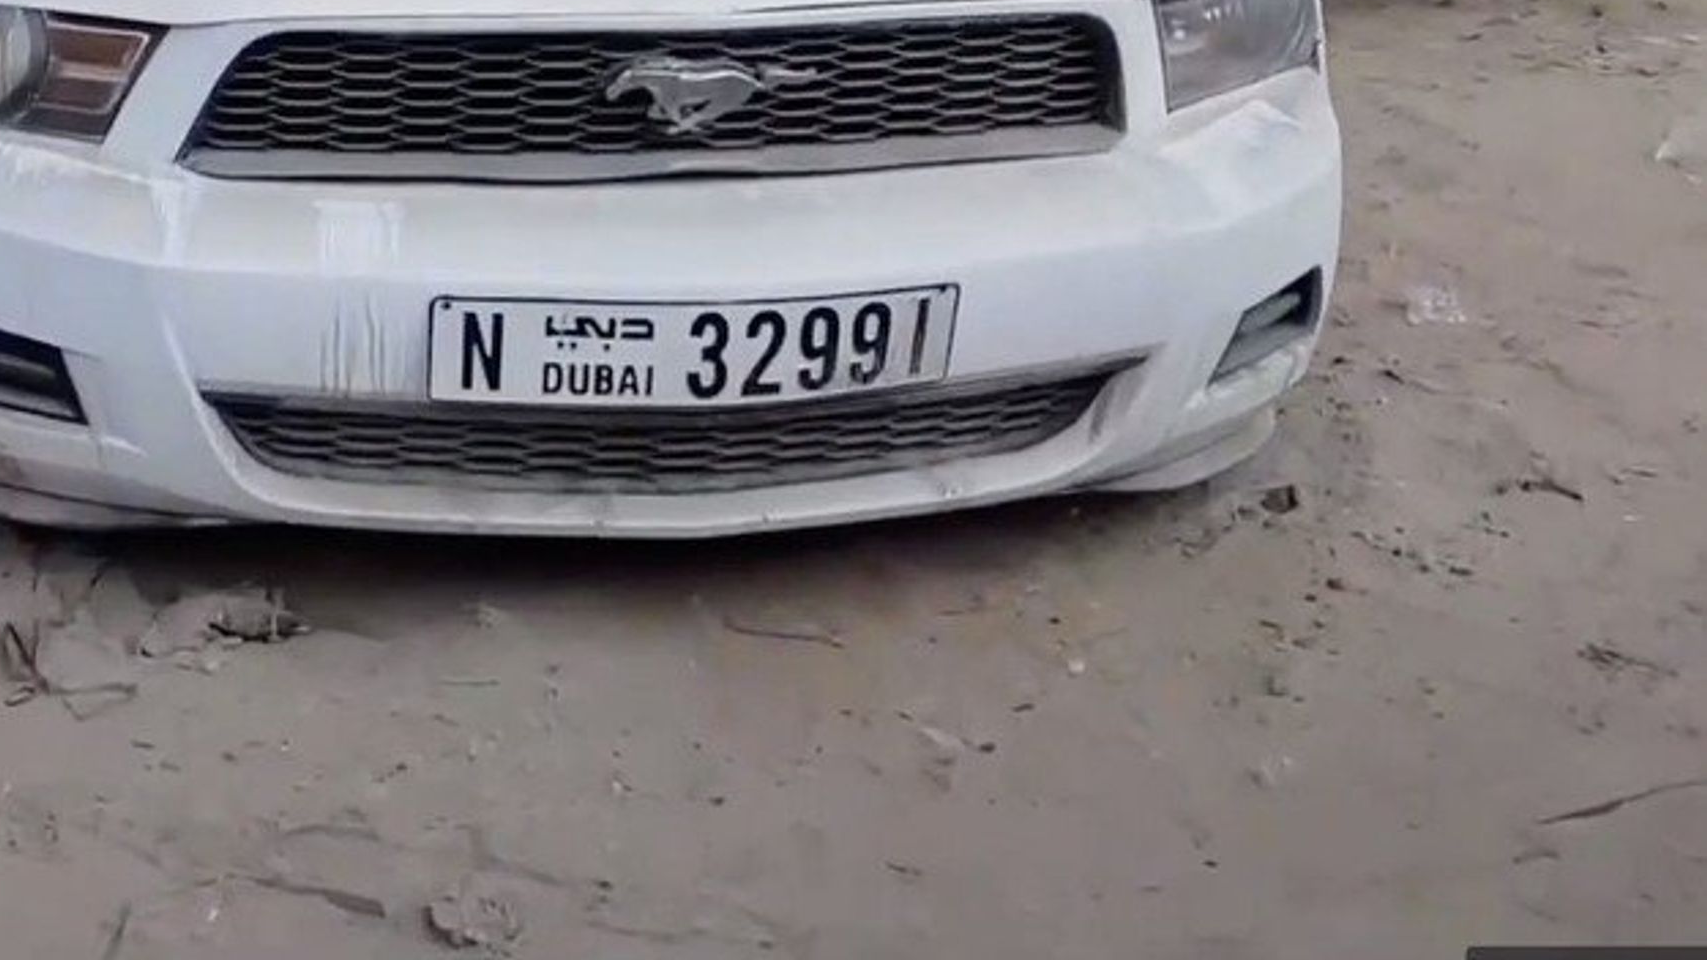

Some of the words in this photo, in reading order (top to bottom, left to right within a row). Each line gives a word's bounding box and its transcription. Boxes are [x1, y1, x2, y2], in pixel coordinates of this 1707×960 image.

[461, 312, 504, 392] N
[545, 315, 654, 353] دبي
[686, 297, 932, 399] 32991
[543, 361, 654, 396] DUBAI
